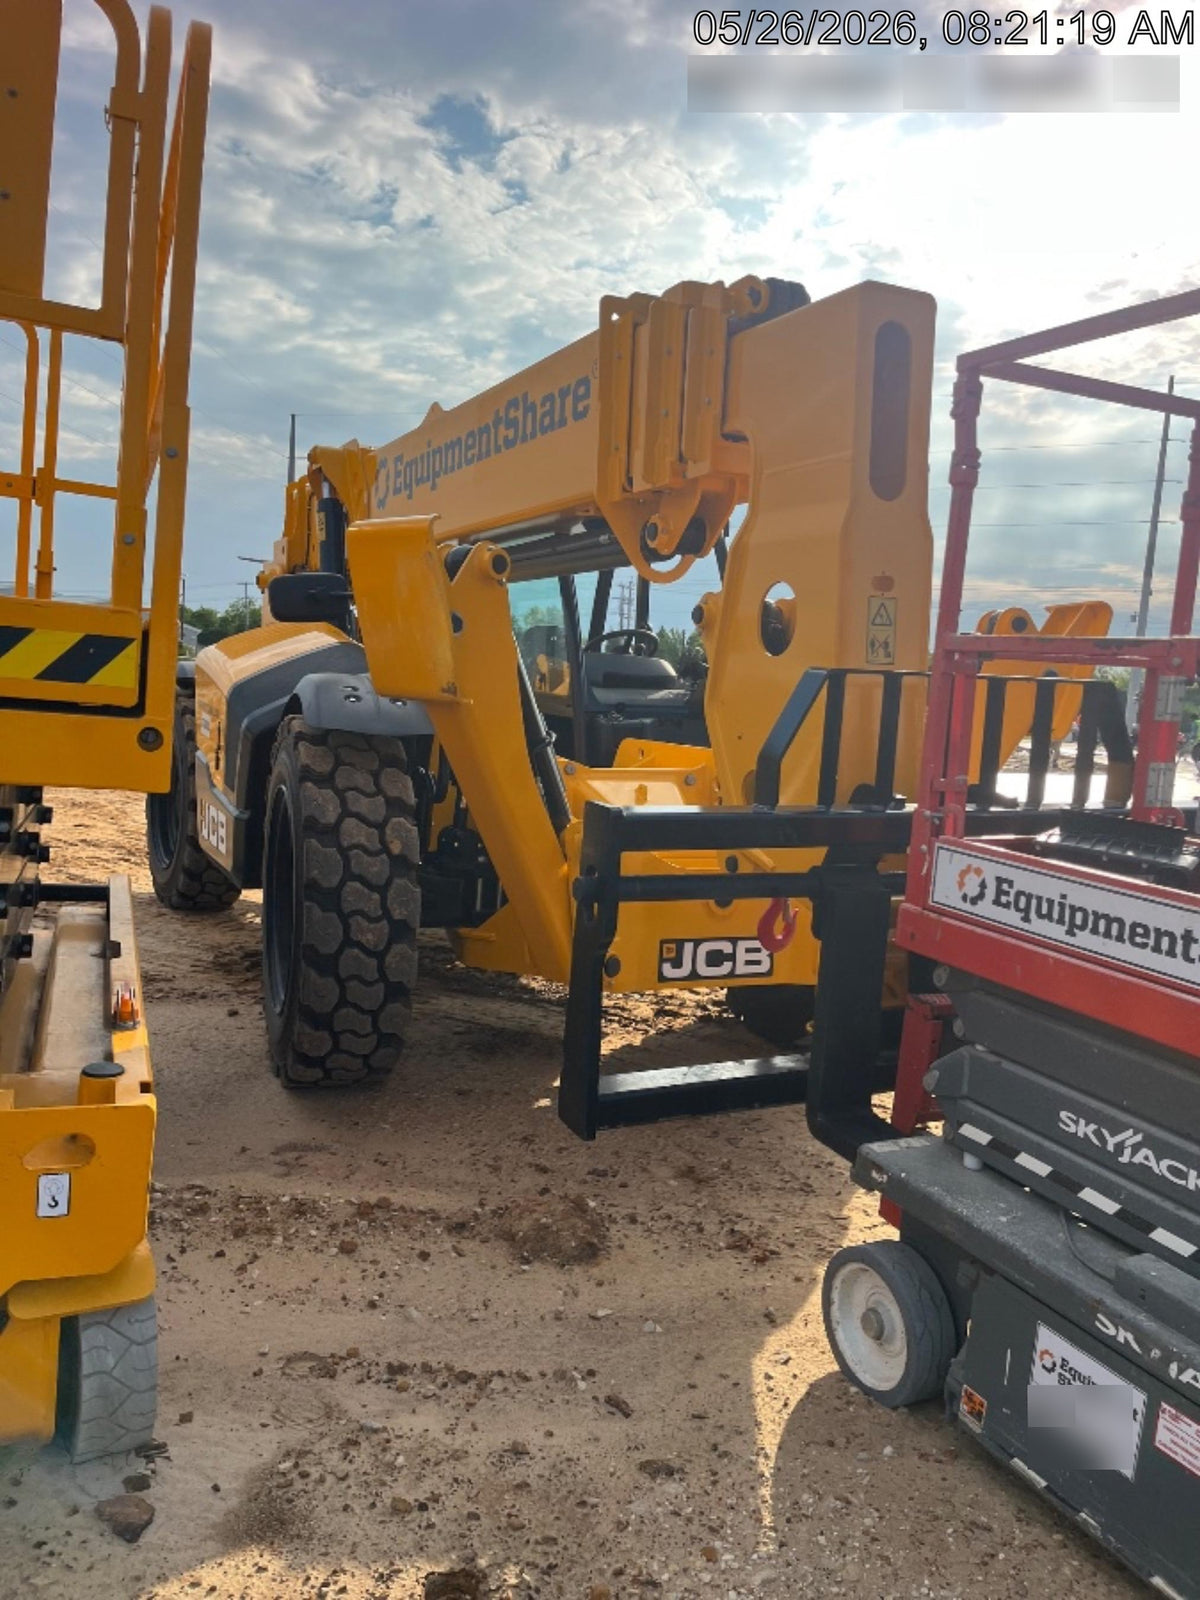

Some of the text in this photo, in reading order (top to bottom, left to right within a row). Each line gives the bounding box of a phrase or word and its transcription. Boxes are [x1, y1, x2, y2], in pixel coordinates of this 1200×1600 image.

[393, 375, 592, 500] EquipmentShare
[201, 801, 226, 855] JCB
[992, 876, 1200, 965] Equipment
[661, 940, 771, 978] JCB
